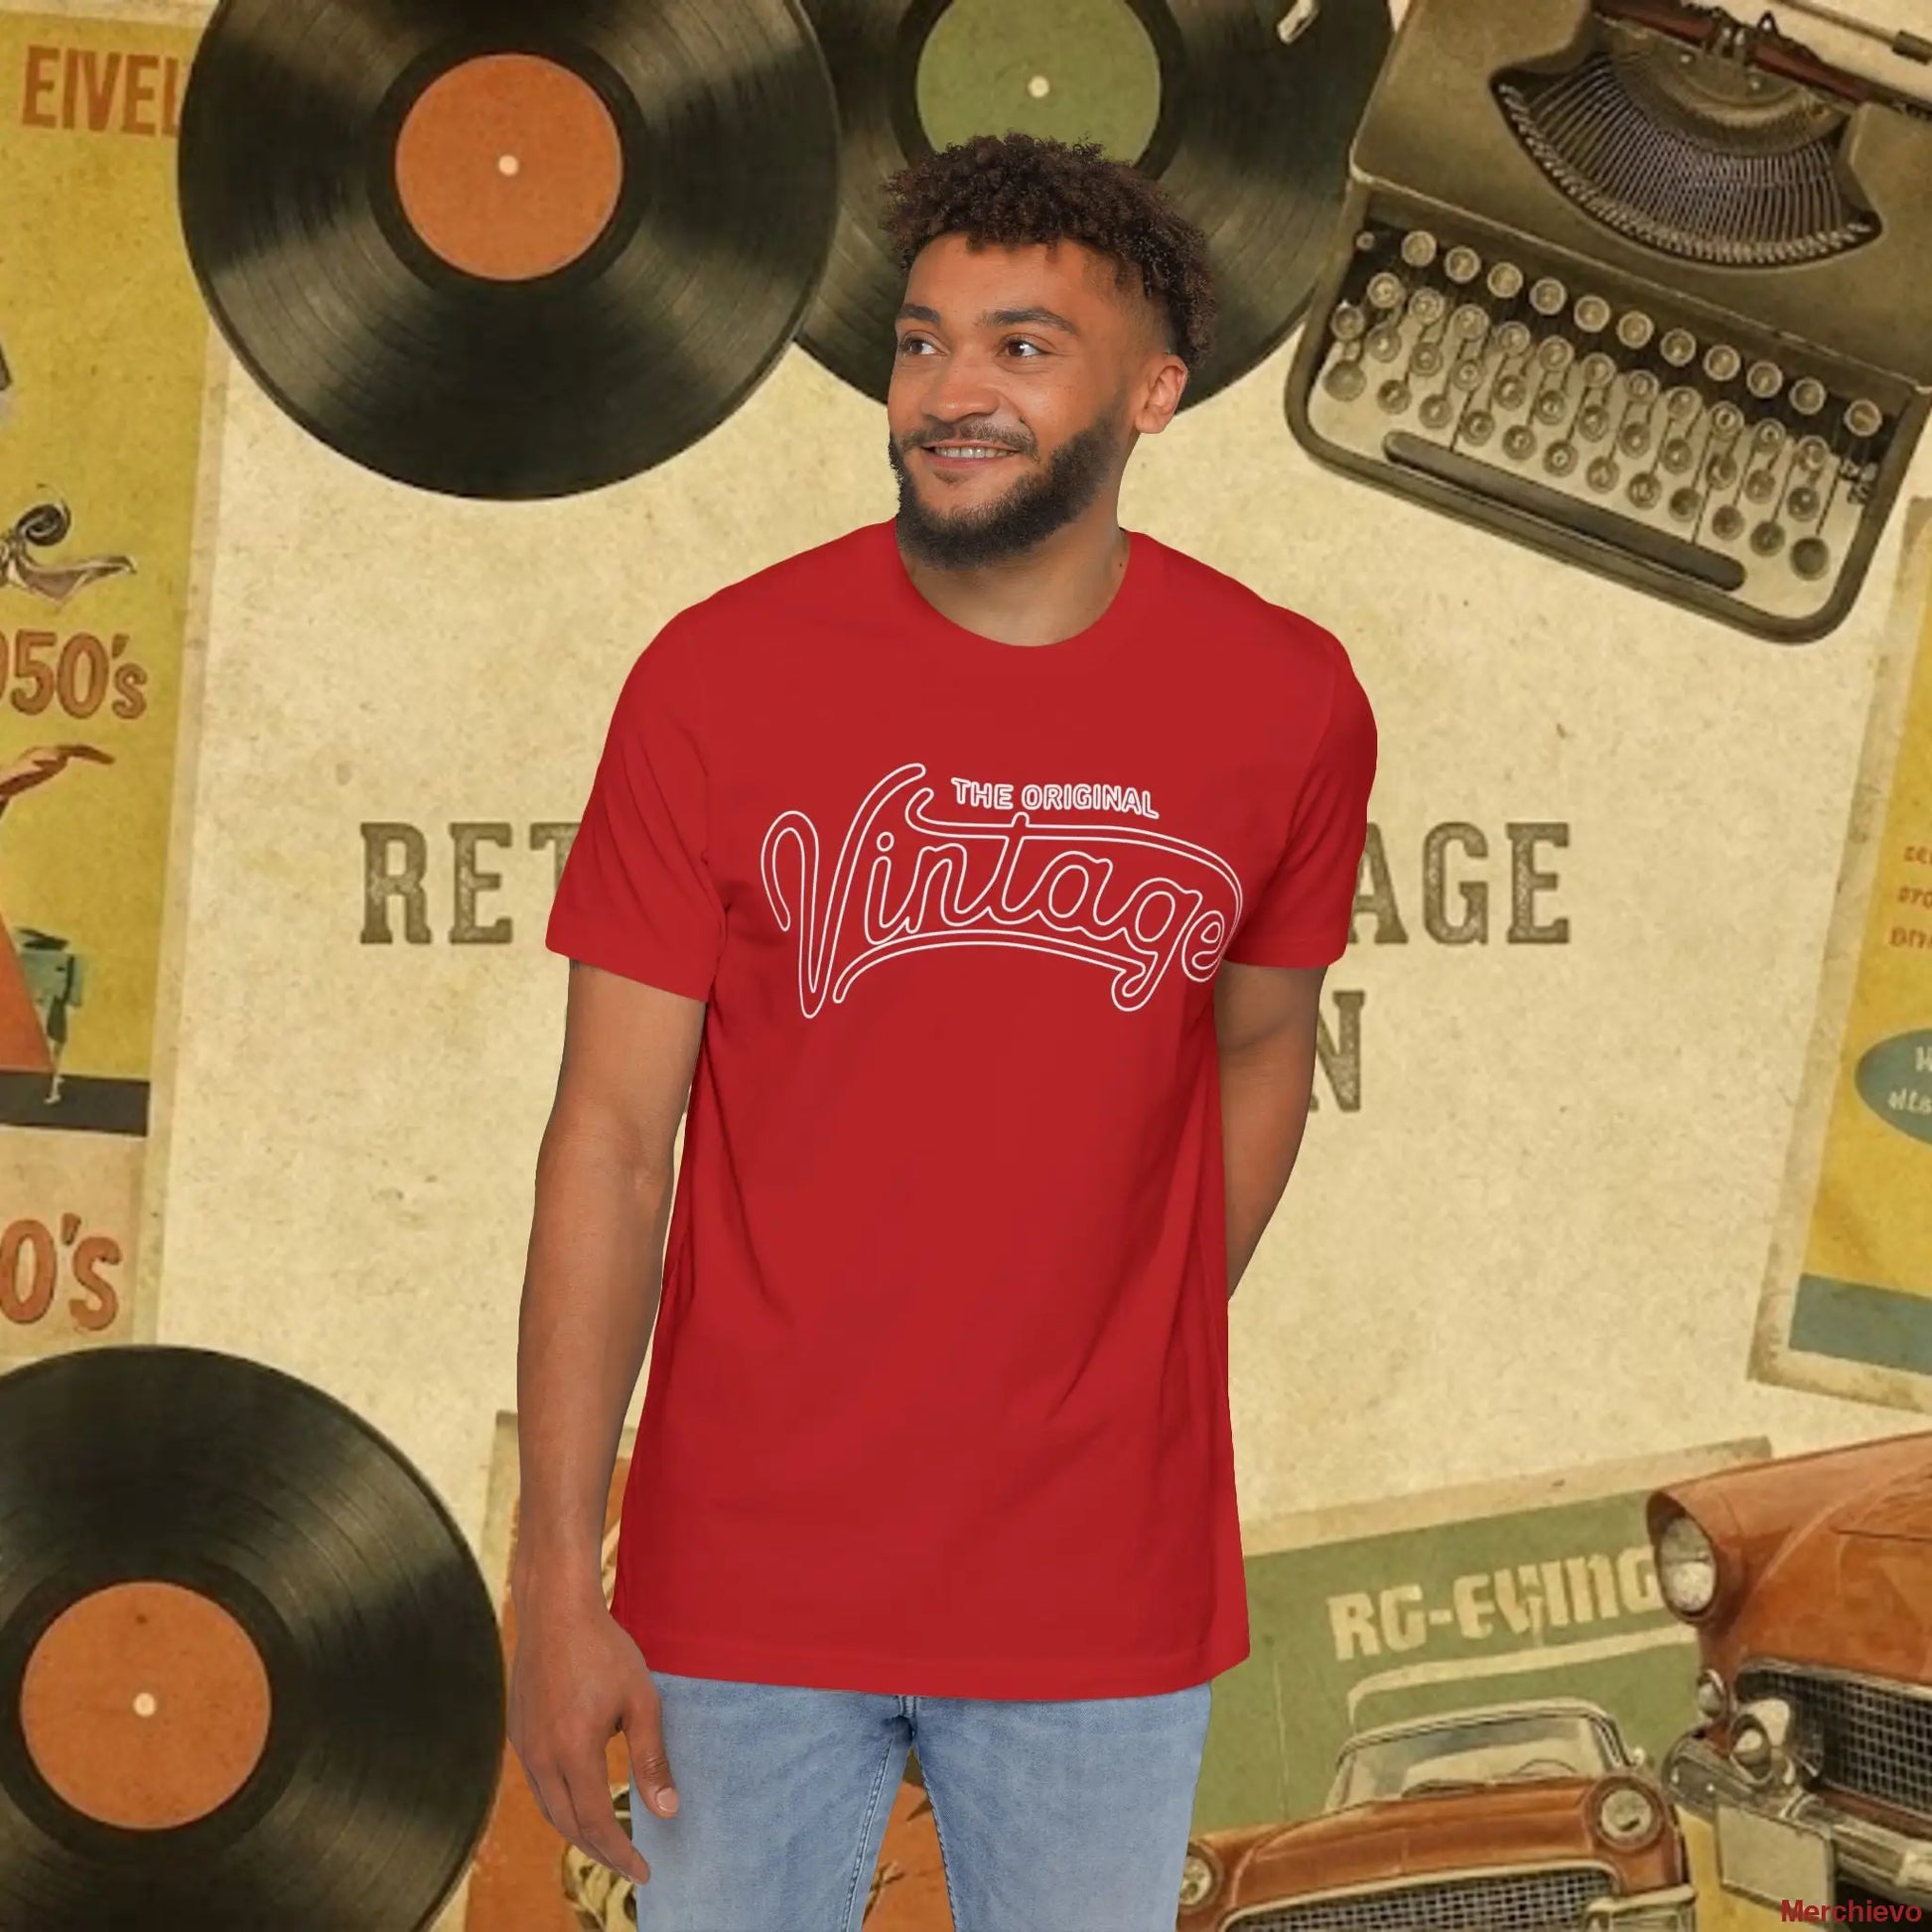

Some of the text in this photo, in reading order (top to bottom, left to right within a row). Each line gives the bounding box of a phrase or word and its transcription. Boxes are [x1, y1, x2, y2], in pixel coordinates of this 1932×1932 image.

[0, 628, 148, 720] 50's
[951, 777, 1160, 820] THE ORIGINAL
[760, 762, 1243, 1020] Vintage
